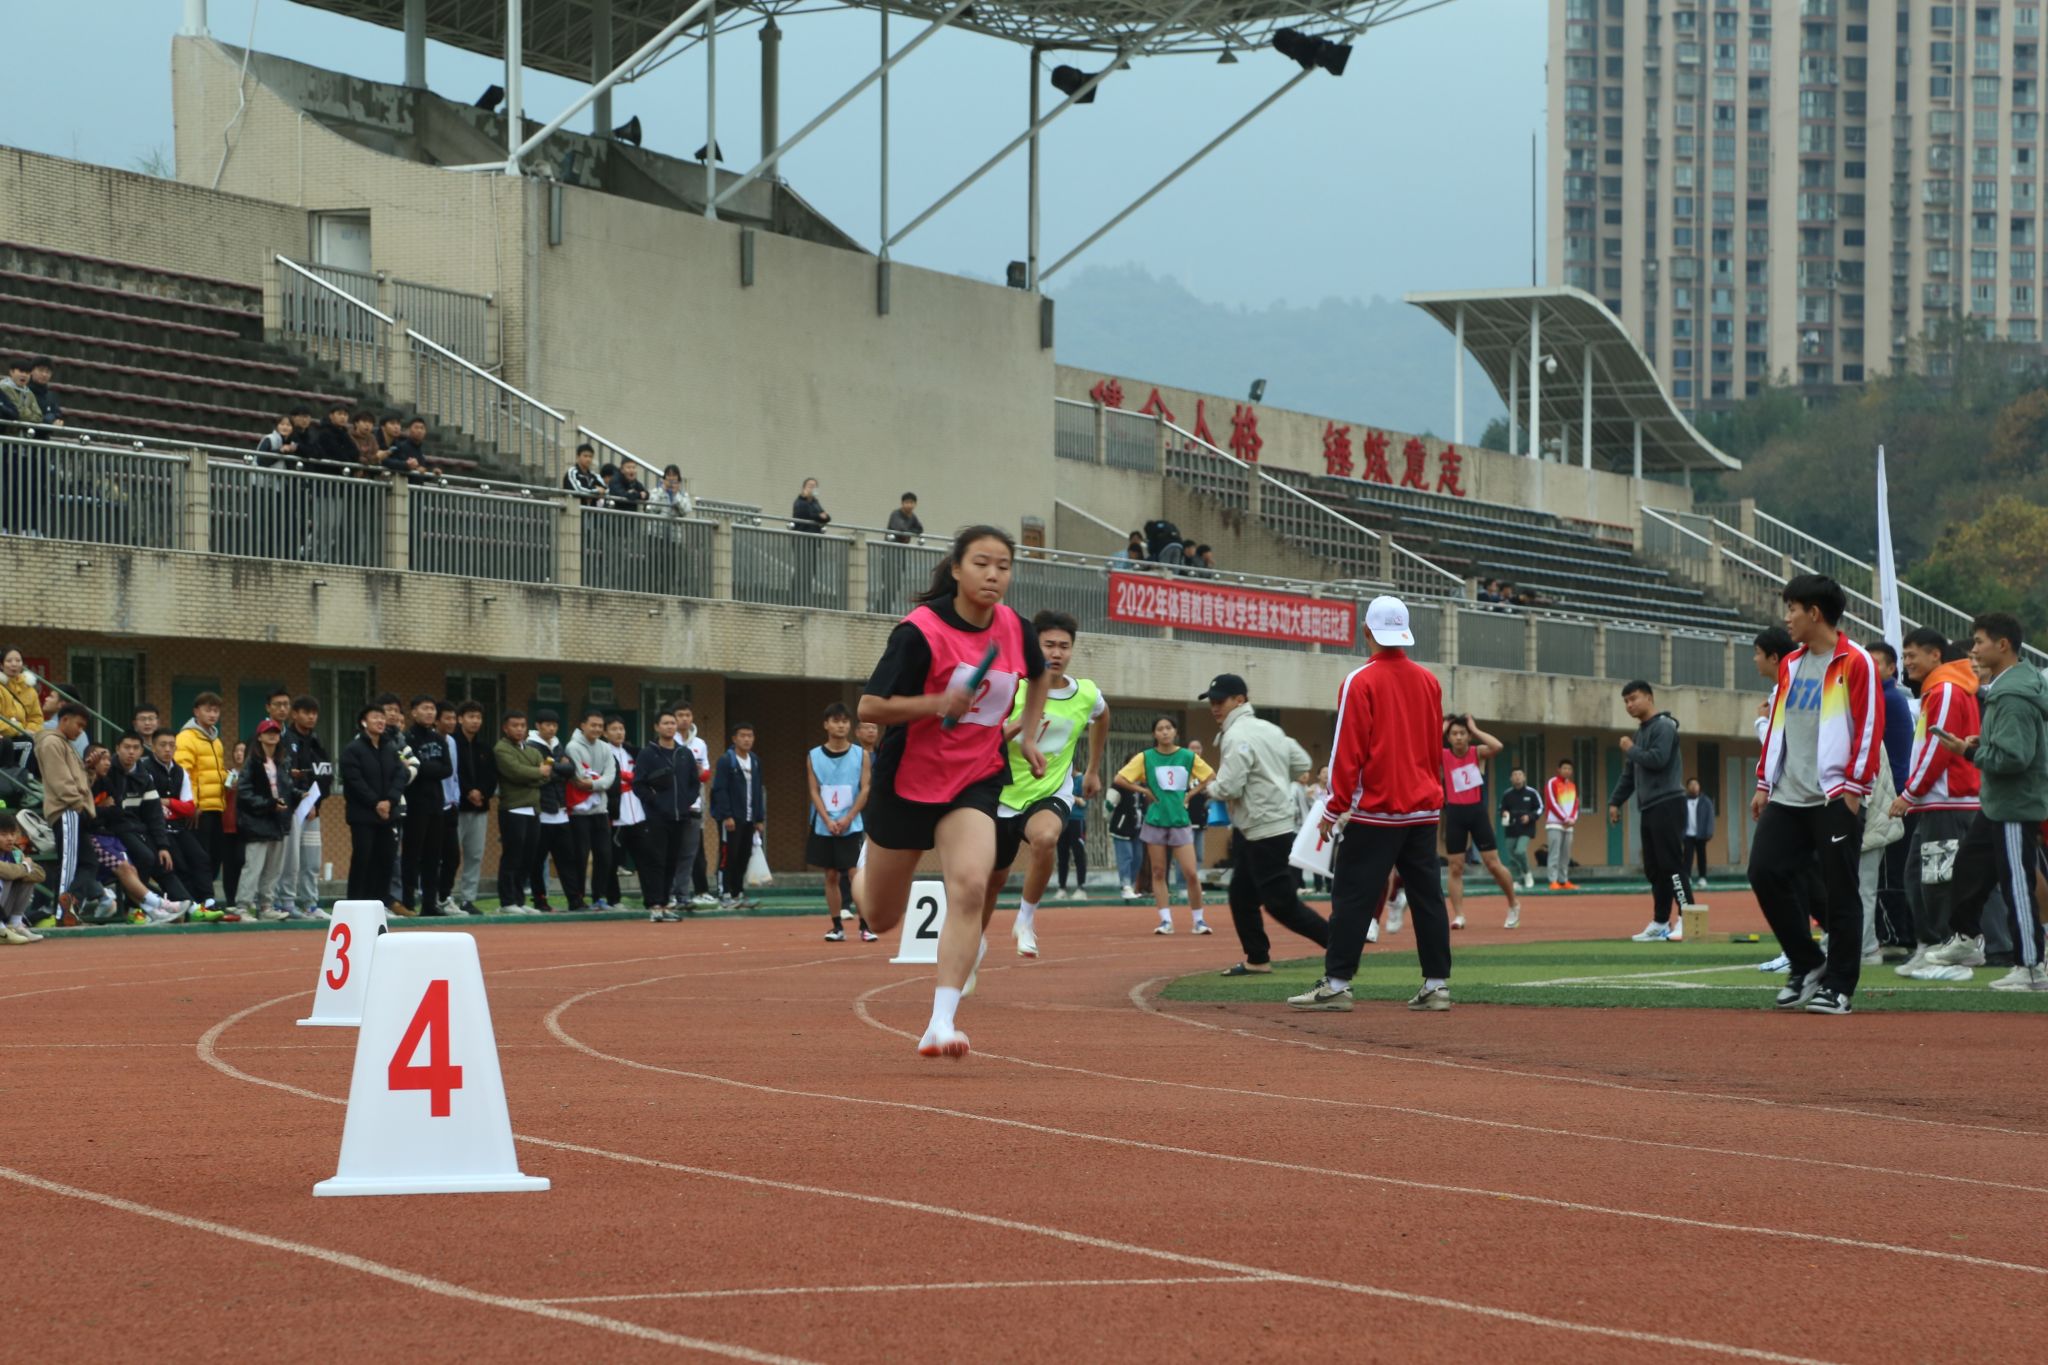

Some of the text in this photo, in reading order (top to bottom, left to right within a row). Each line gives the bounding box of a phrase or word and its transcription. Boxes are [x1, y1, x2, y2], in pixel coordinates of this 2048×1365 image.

[969, 679, 991, 713] 2
[1167, 770, 1175, 786] 3
[1461, 769, 1471, 785] 2
[831, 791, 839, 807] 4
[915, 895, 939, 939] 2
[326, 922, 352, 991] 3
[387, 979, 463, 1118] 4
